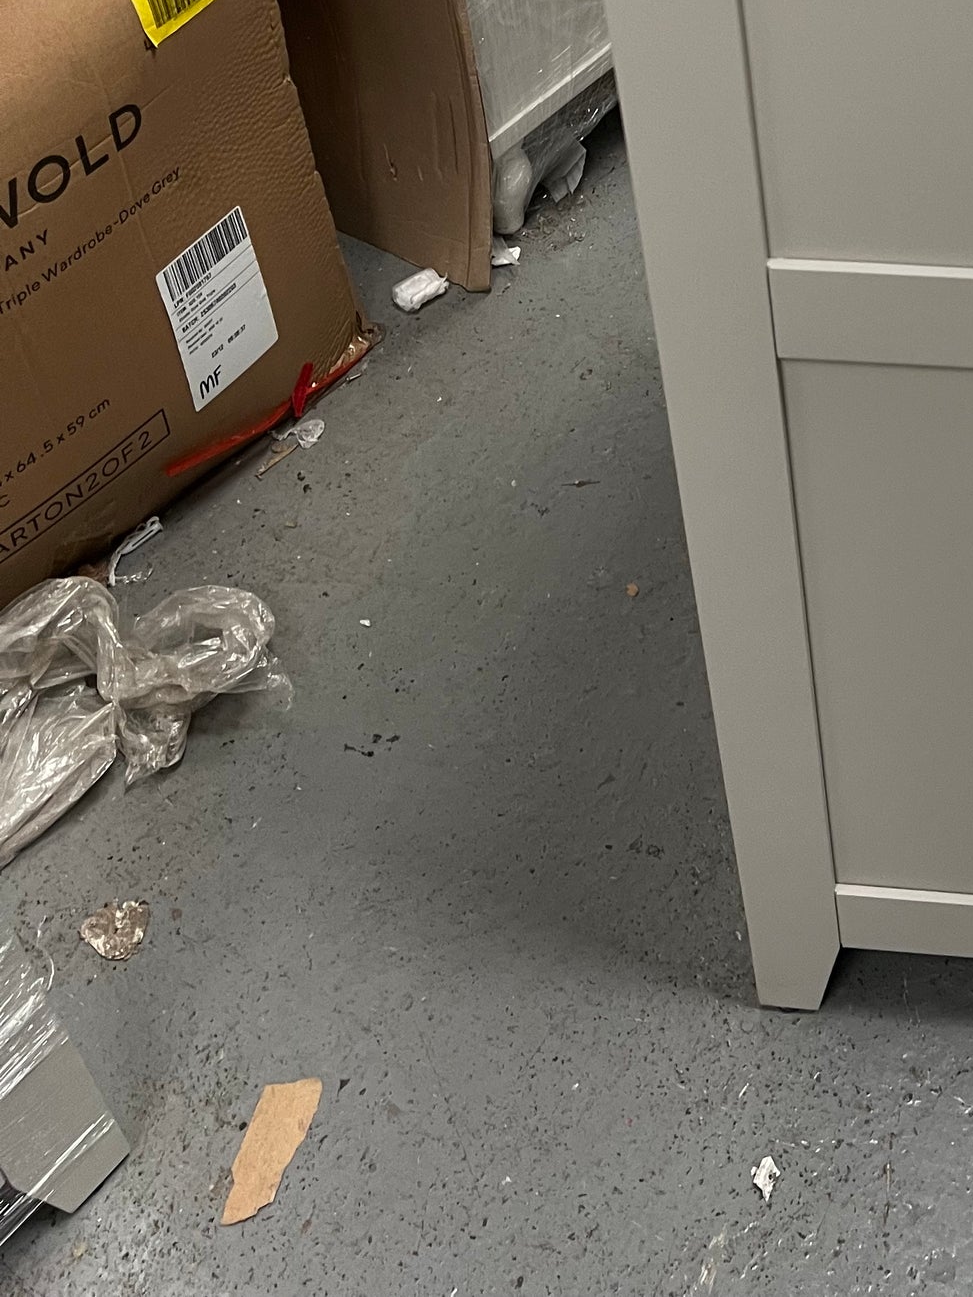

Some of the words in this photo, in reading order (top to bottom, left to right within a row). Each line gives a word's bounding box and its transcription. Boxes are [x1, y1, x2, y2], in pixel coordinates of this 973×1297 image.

[151, 167, 180, 196] Grey
[199, 364, 222, 399] MF
[56, 433, 65, 445] x
[67, 415, 85, 436] 59
[88, 398, 111, 420] cm
